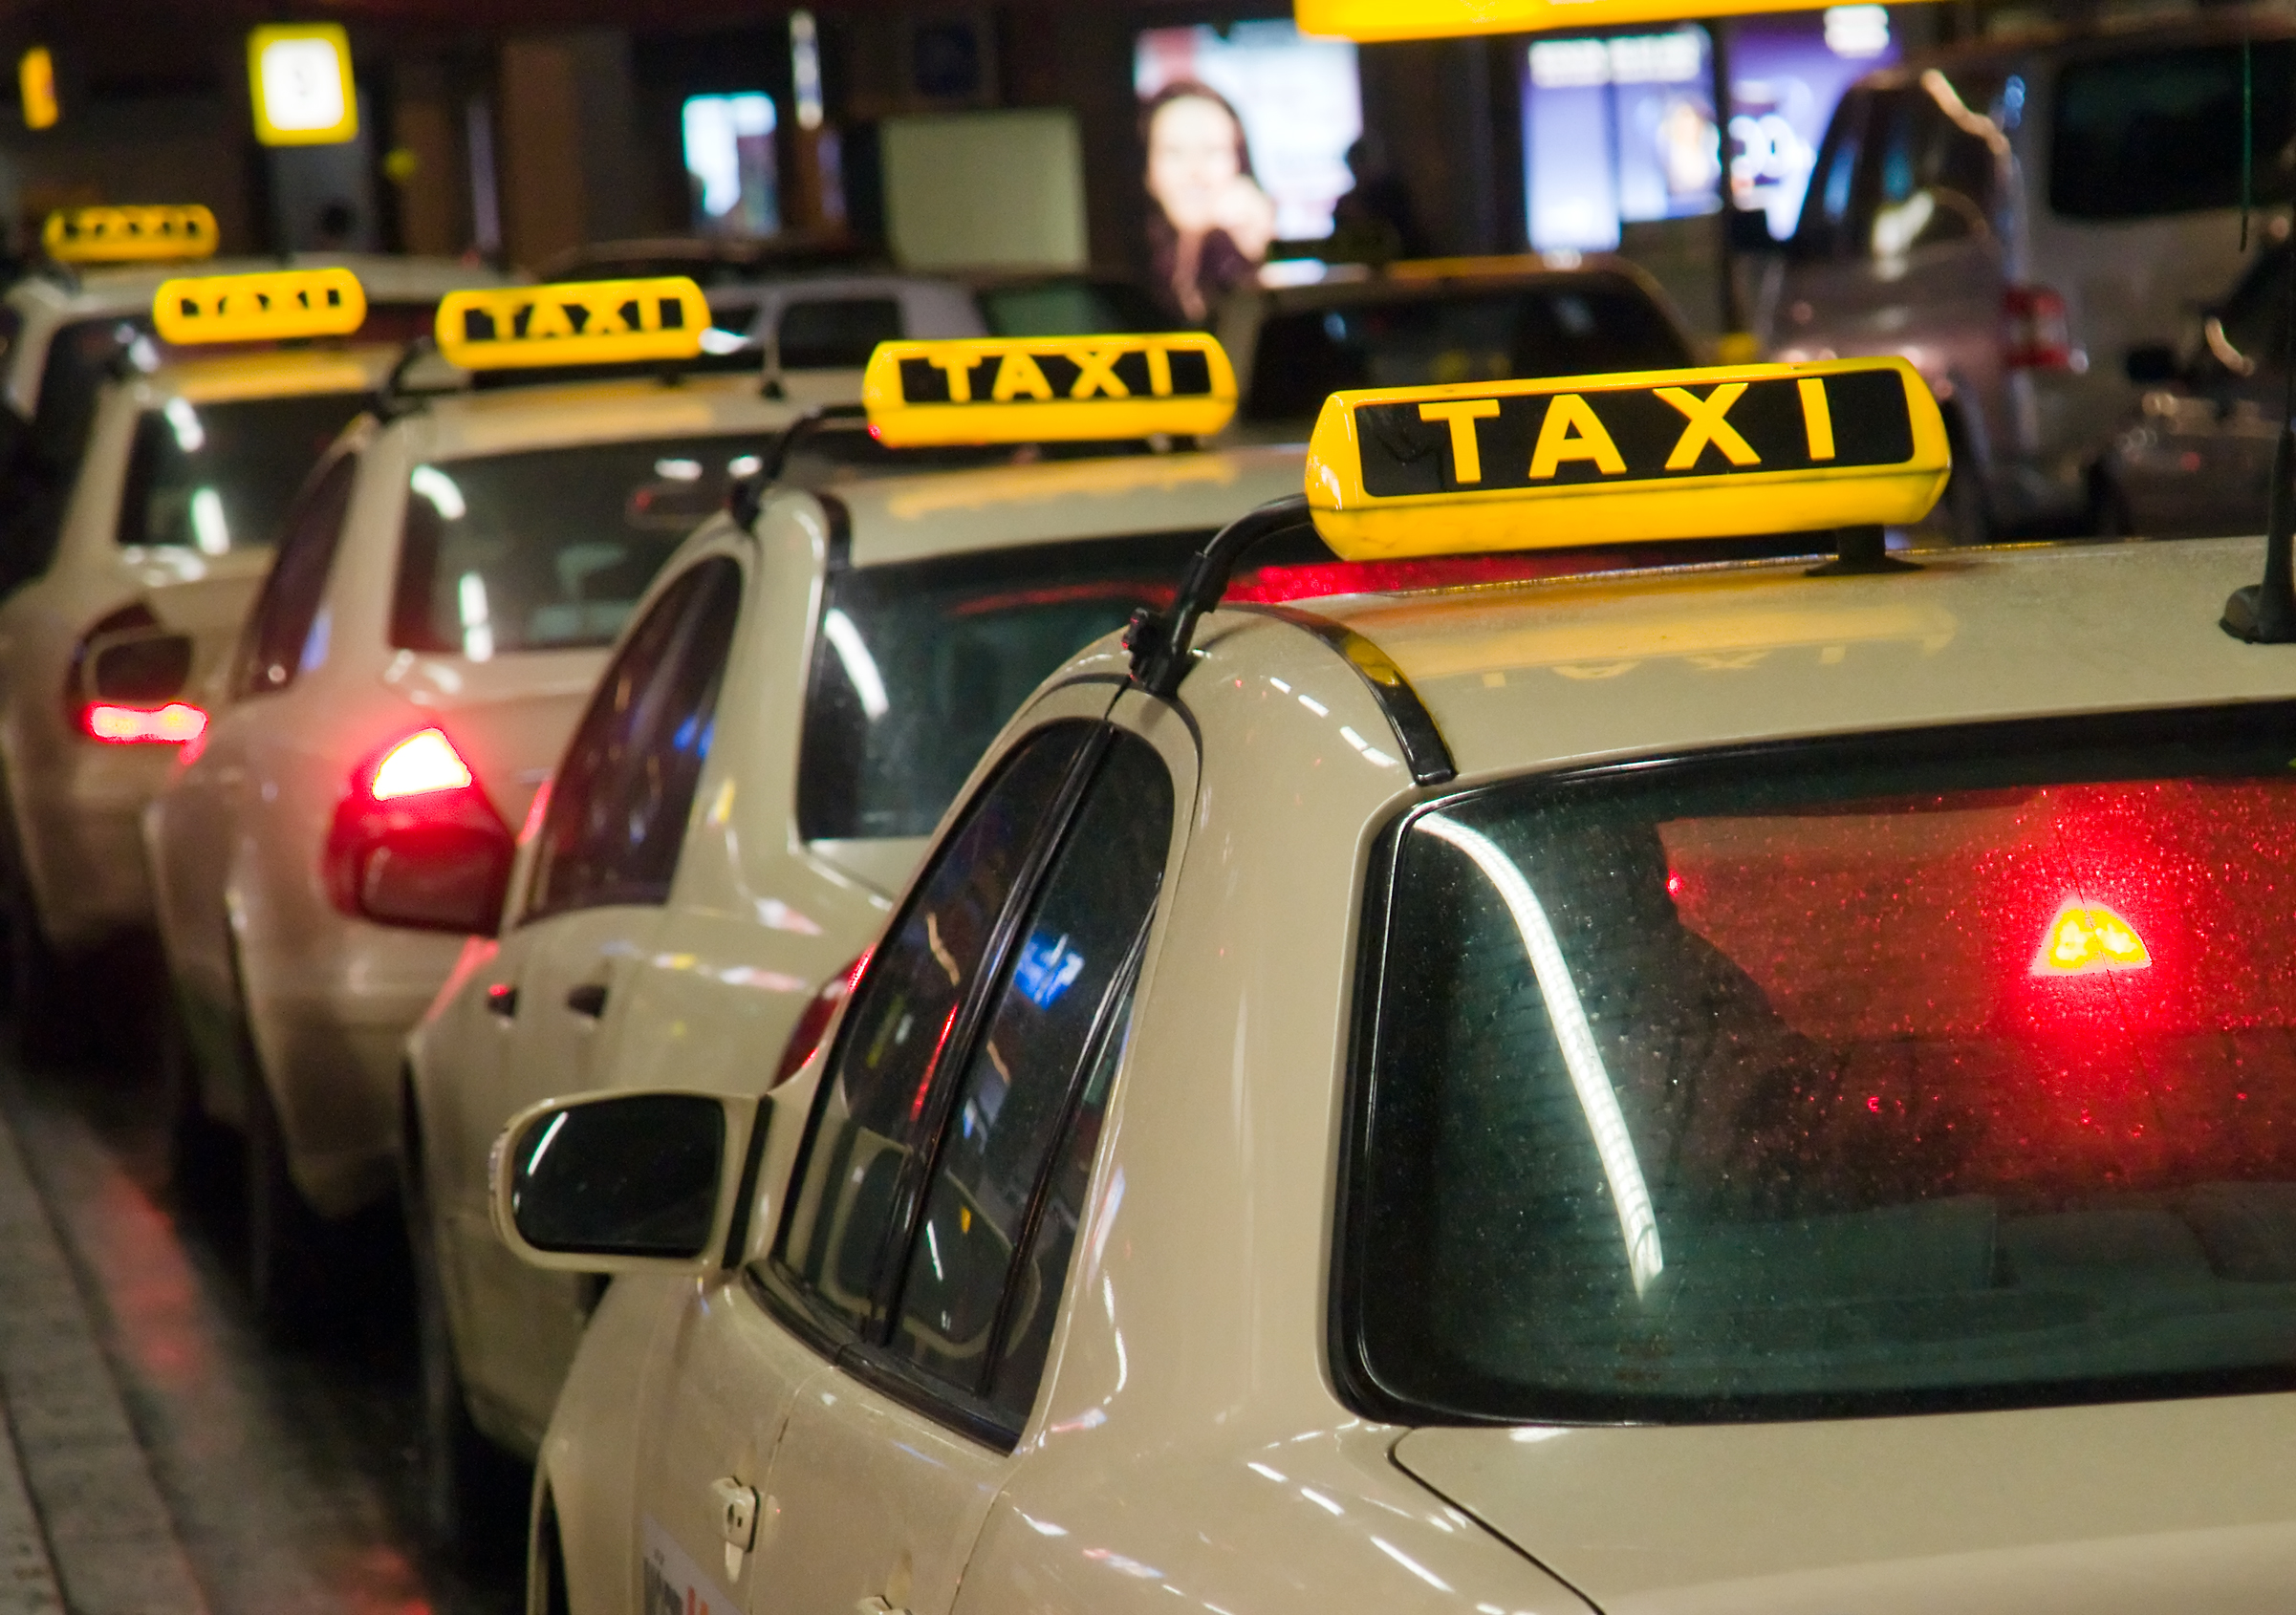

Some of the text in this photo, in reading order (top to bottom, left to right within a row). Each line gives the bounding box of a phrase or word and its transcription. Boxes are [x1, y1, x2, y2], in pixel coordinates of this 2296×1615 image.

[480, 298, 662, 341] TAXI
[928, 348, 1174, 403] TAXI
[1419, 377, 1836, 484] TAXI
